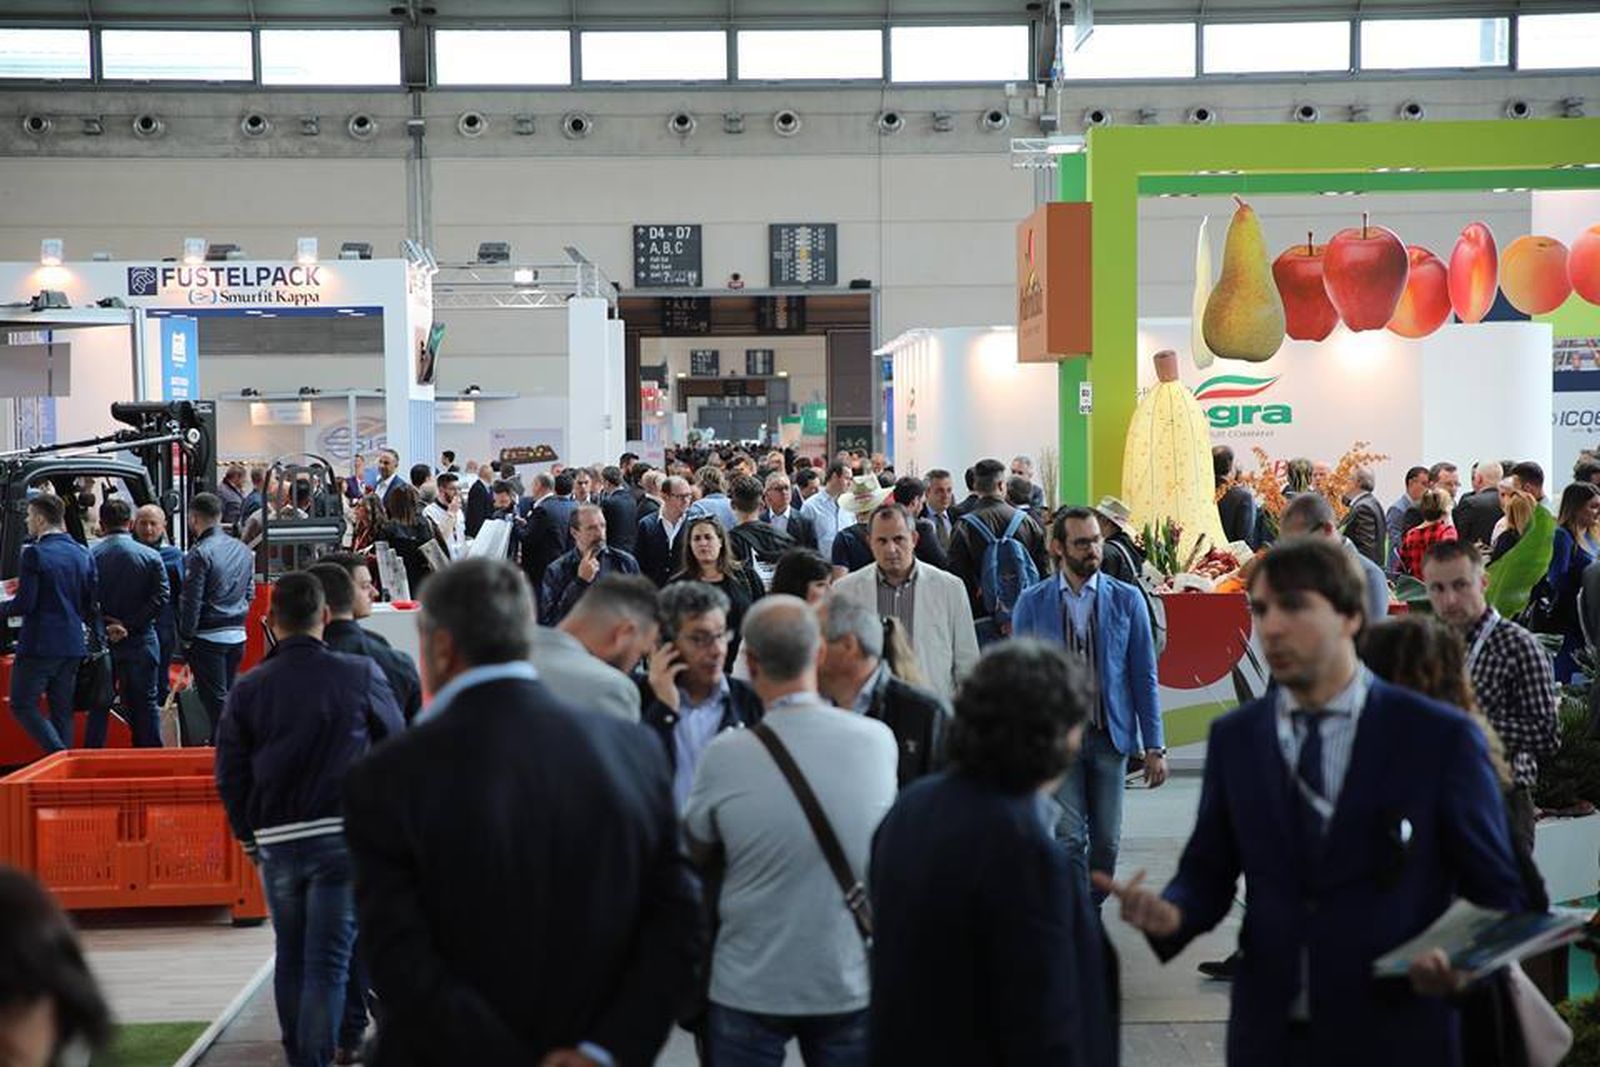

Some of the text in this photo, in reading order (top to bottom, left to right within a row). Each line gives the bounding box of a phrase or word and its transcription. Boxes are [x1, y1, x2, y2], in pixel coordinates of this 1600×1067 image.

[649, 227, 665, 240] D4
[161, 266, 319, 287] FUSTELPACK
[219, 290, 319, 306] Smurfit Kappa
[1204, 403, 1292, 429] gra
